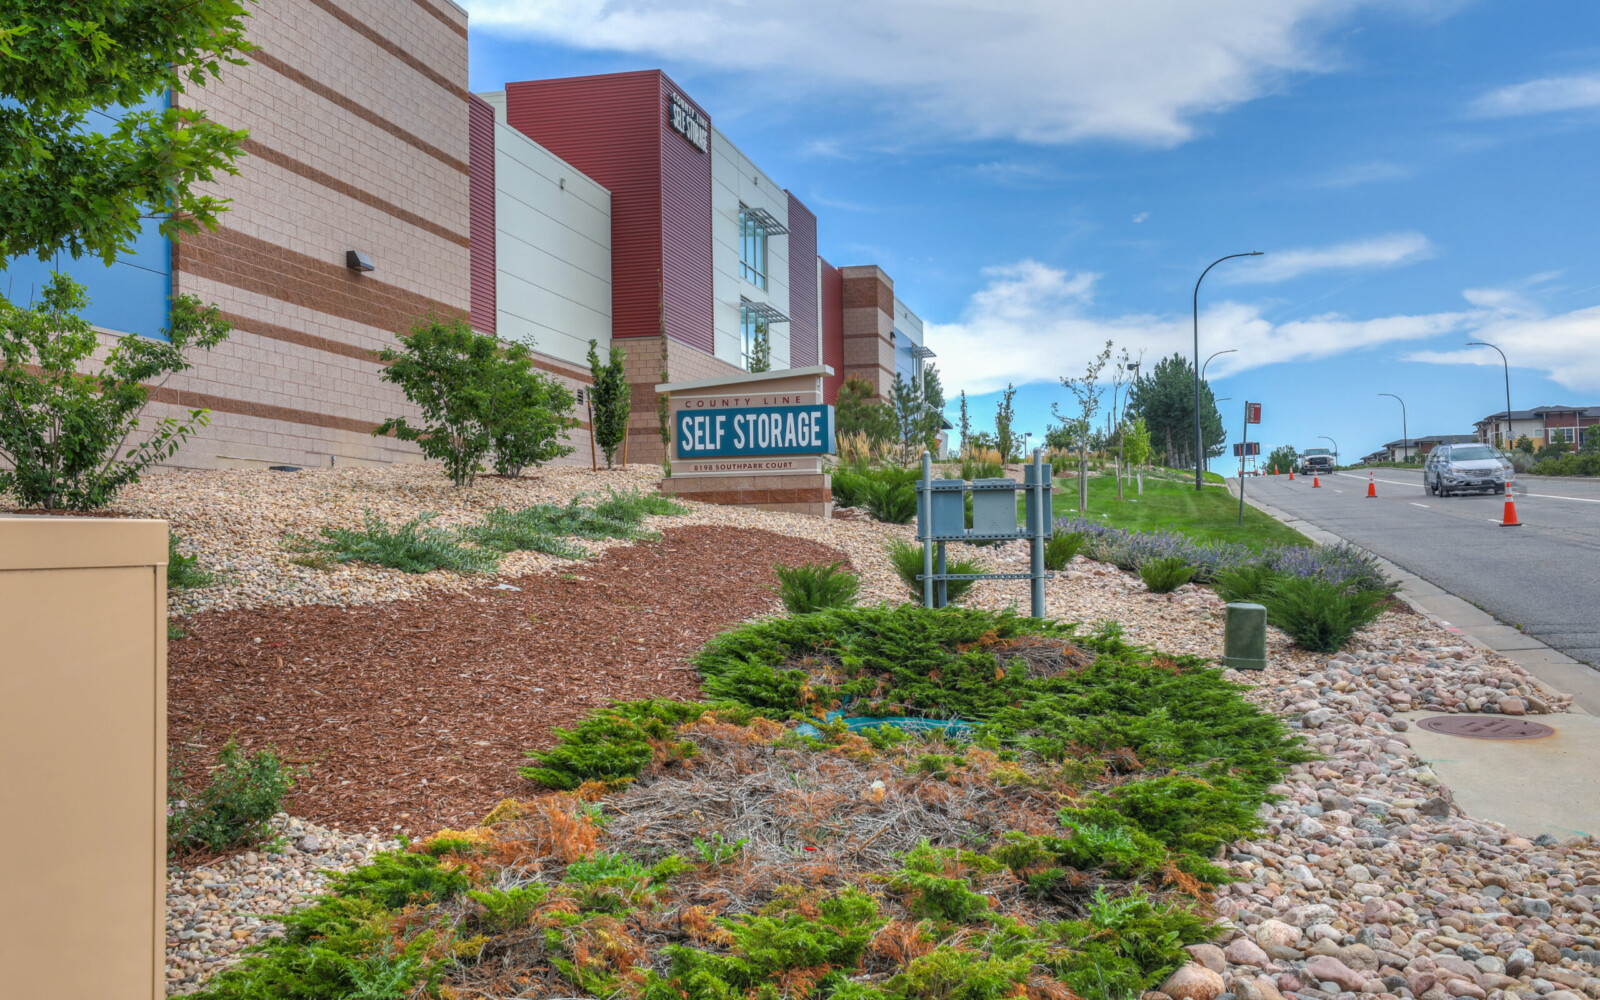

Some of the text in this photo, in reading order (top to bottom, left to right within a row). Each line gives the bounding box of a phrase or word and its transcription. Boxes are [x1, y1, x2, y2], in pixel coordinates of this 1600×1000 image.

[673, 103, 708, 154] SELF STORAGE
[685, 395, 801, 409] COUNTY LINE
[681, 411, 822, 451] SELF STORAGE
[693, 461, 793, 472] 8198 SOUTHPARK COURT
